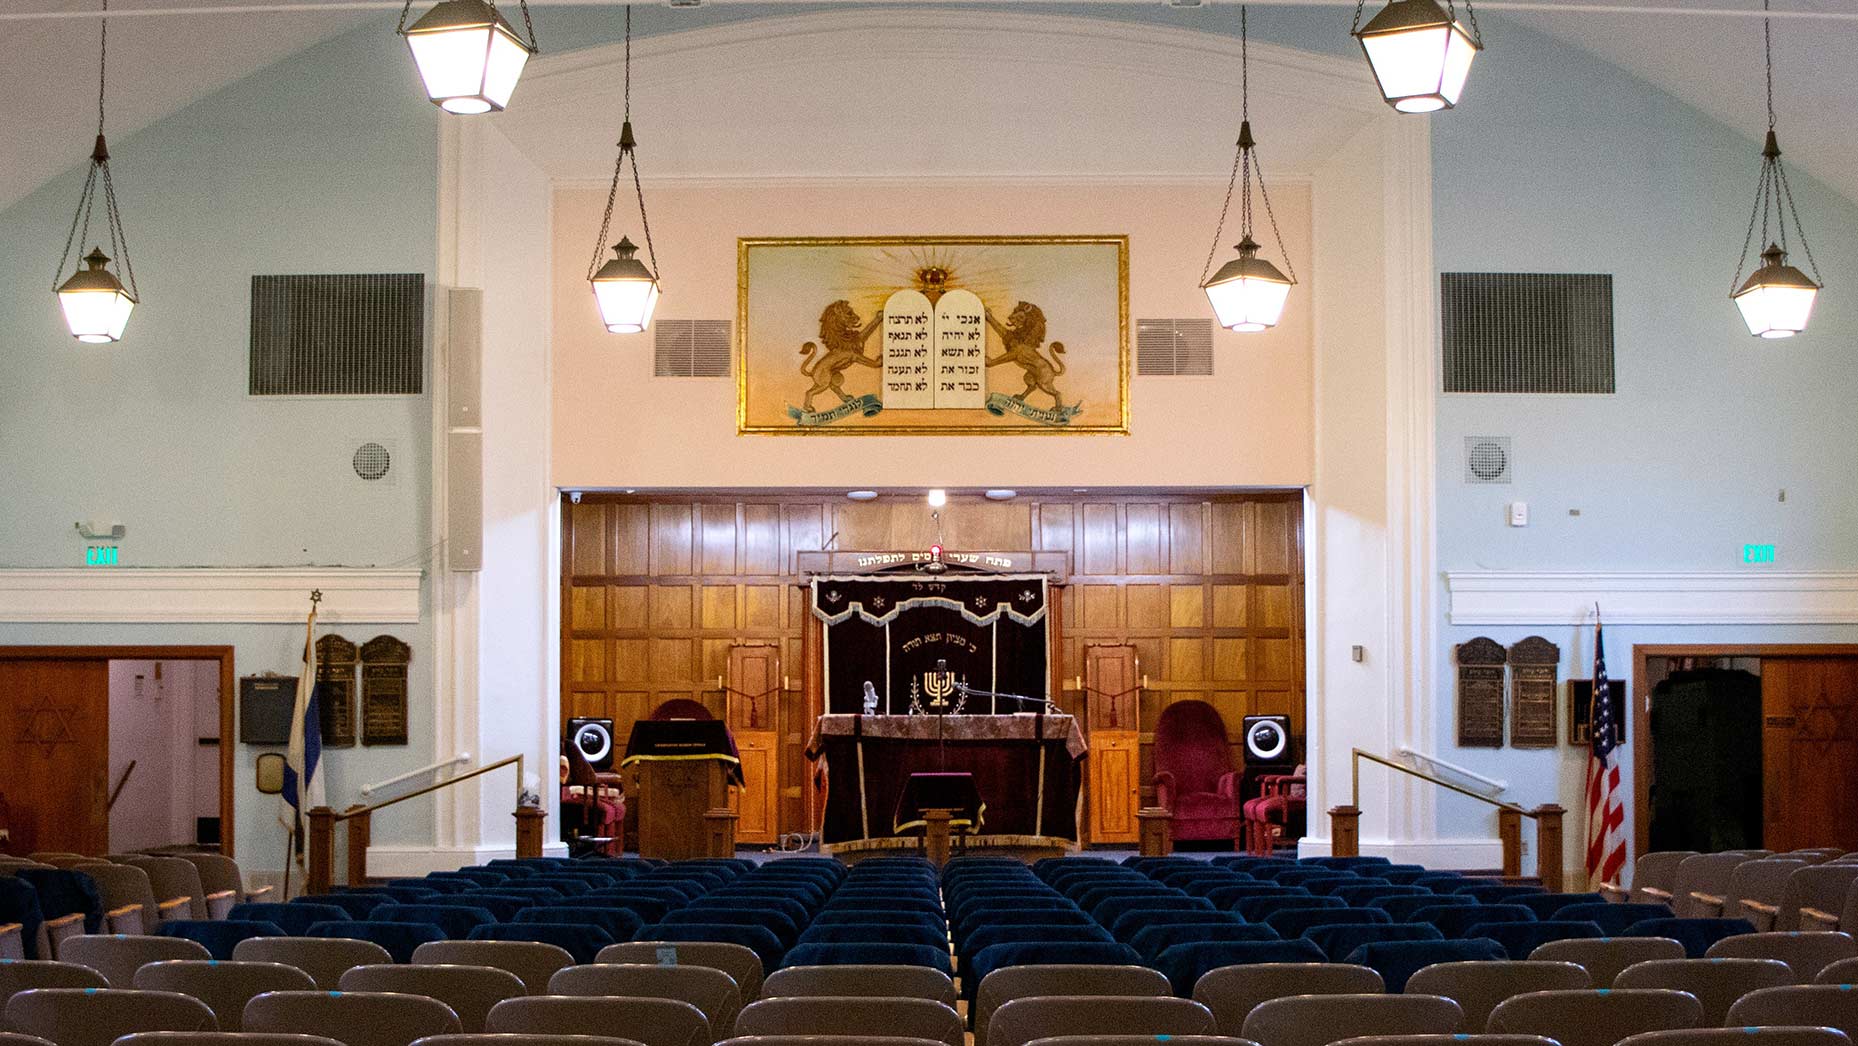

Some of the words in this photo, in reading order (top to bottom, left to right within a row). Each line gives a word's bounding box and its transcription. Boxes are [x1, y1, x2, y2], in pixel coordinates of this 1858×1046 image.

[889, 315, 913, 324] תרצח
[915, 312, 928, 324] לא
[956, 315, 981, 325] אנכי
[888, 332, 912, 343] תנאף
[915, 327, 927, 340] לא
[942, 331, 964, 340] יהיה
[968, 327, 980, 340] לא
[889, 349, 911, 358] תגנב
[914, 344, 927, 357] לא
[941, 348, 964, 357] תשא
[967, 344, 980, 357] לא
[888, 366, 912, 375] תענה
[915, 362, 928, 374] לא
[941, 366, 955, 374] את
[958, 365, 979, 374] זכור
[888, 382, 912, 391] תחמד
[915, 377, 928, 391] לא
[940, 382, 955, 391] את
[958, 382, 980, 391] כבד
[87, 546, 118, 565] EXIT
[949, 553, 979, 563] שערי
[1744, 544, 1774, 563] EXIT
[858, 552, 905, 567] לתפלתנו
[985, 555, 1012, 567] פתח
[924, 632, 942, 643] תצא
[902, 637, 922, 653] תורה
